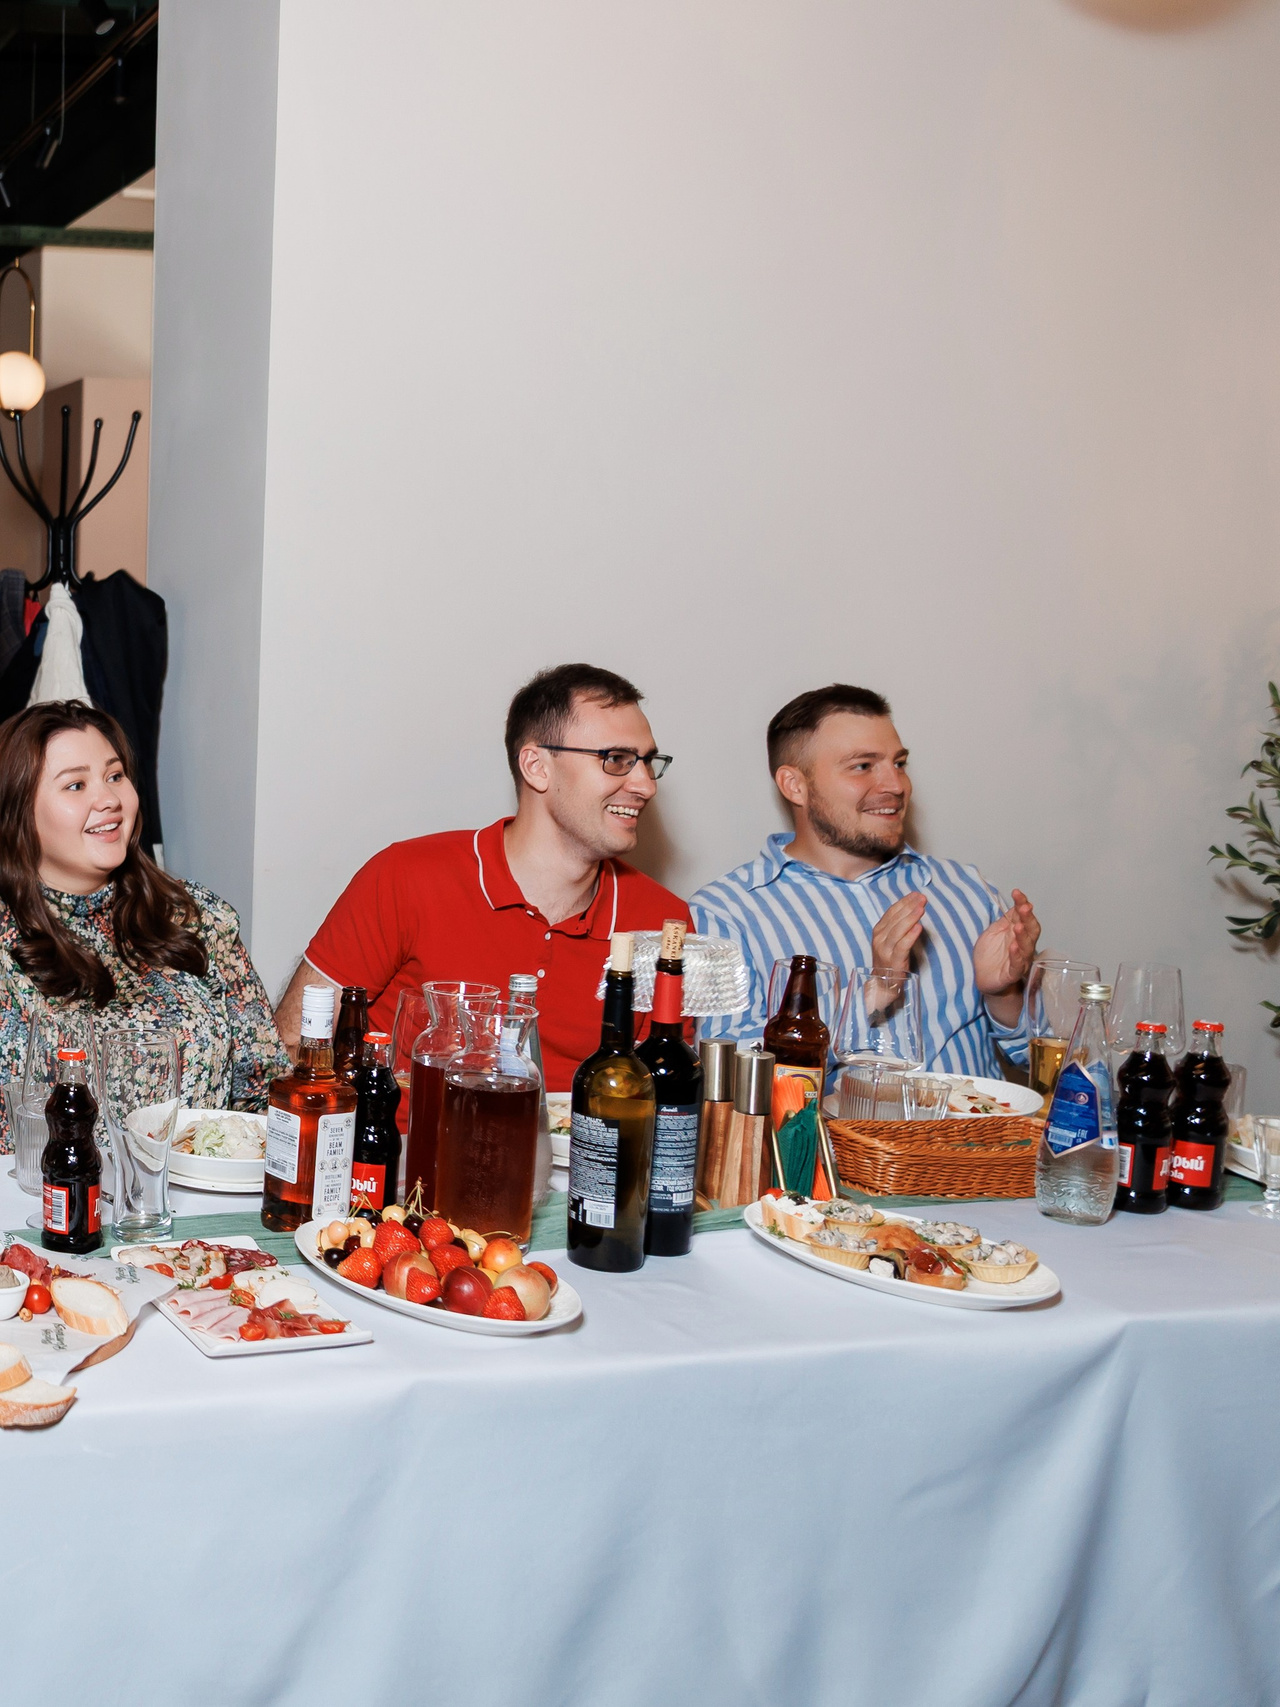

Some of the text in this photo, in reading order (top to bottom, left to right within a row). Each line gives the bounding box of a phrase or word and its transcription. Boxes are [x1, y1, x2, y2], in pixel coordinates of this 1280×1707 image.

[329, 1141, 343, 1149] BEAM
[326, 1148, 344, 1157] FAMILY
[323, 1187, 341, 1196] FAMILY
[323, 1194, 340, 1203] RECIPE
